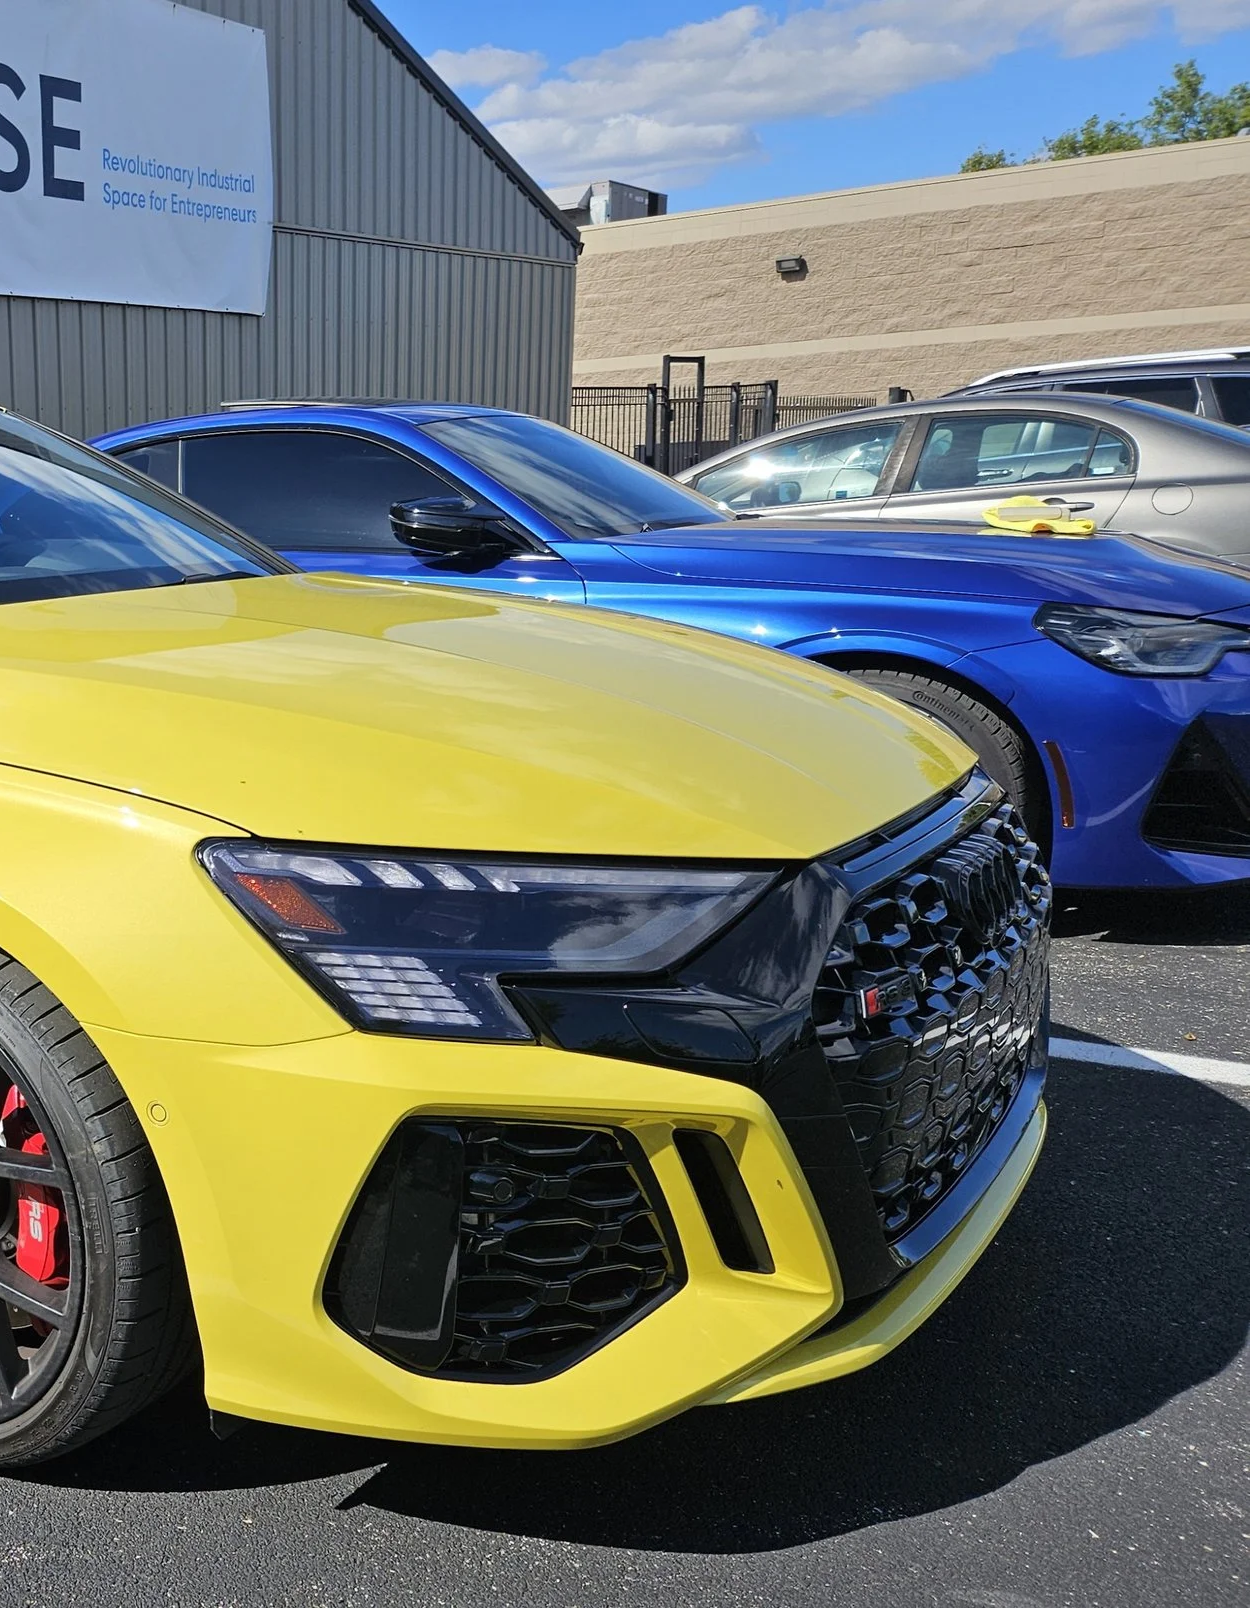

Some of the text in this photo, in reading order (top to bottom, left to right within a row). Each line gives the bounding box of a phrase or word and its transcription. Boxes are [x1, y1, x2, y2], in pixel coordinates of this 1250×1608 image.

[102, 148, 255, 193] Revolutionary Industrial
[103, 182, 257, 223] Space for Entrepreneurs
[27, 1197, 44, 1242] RS
